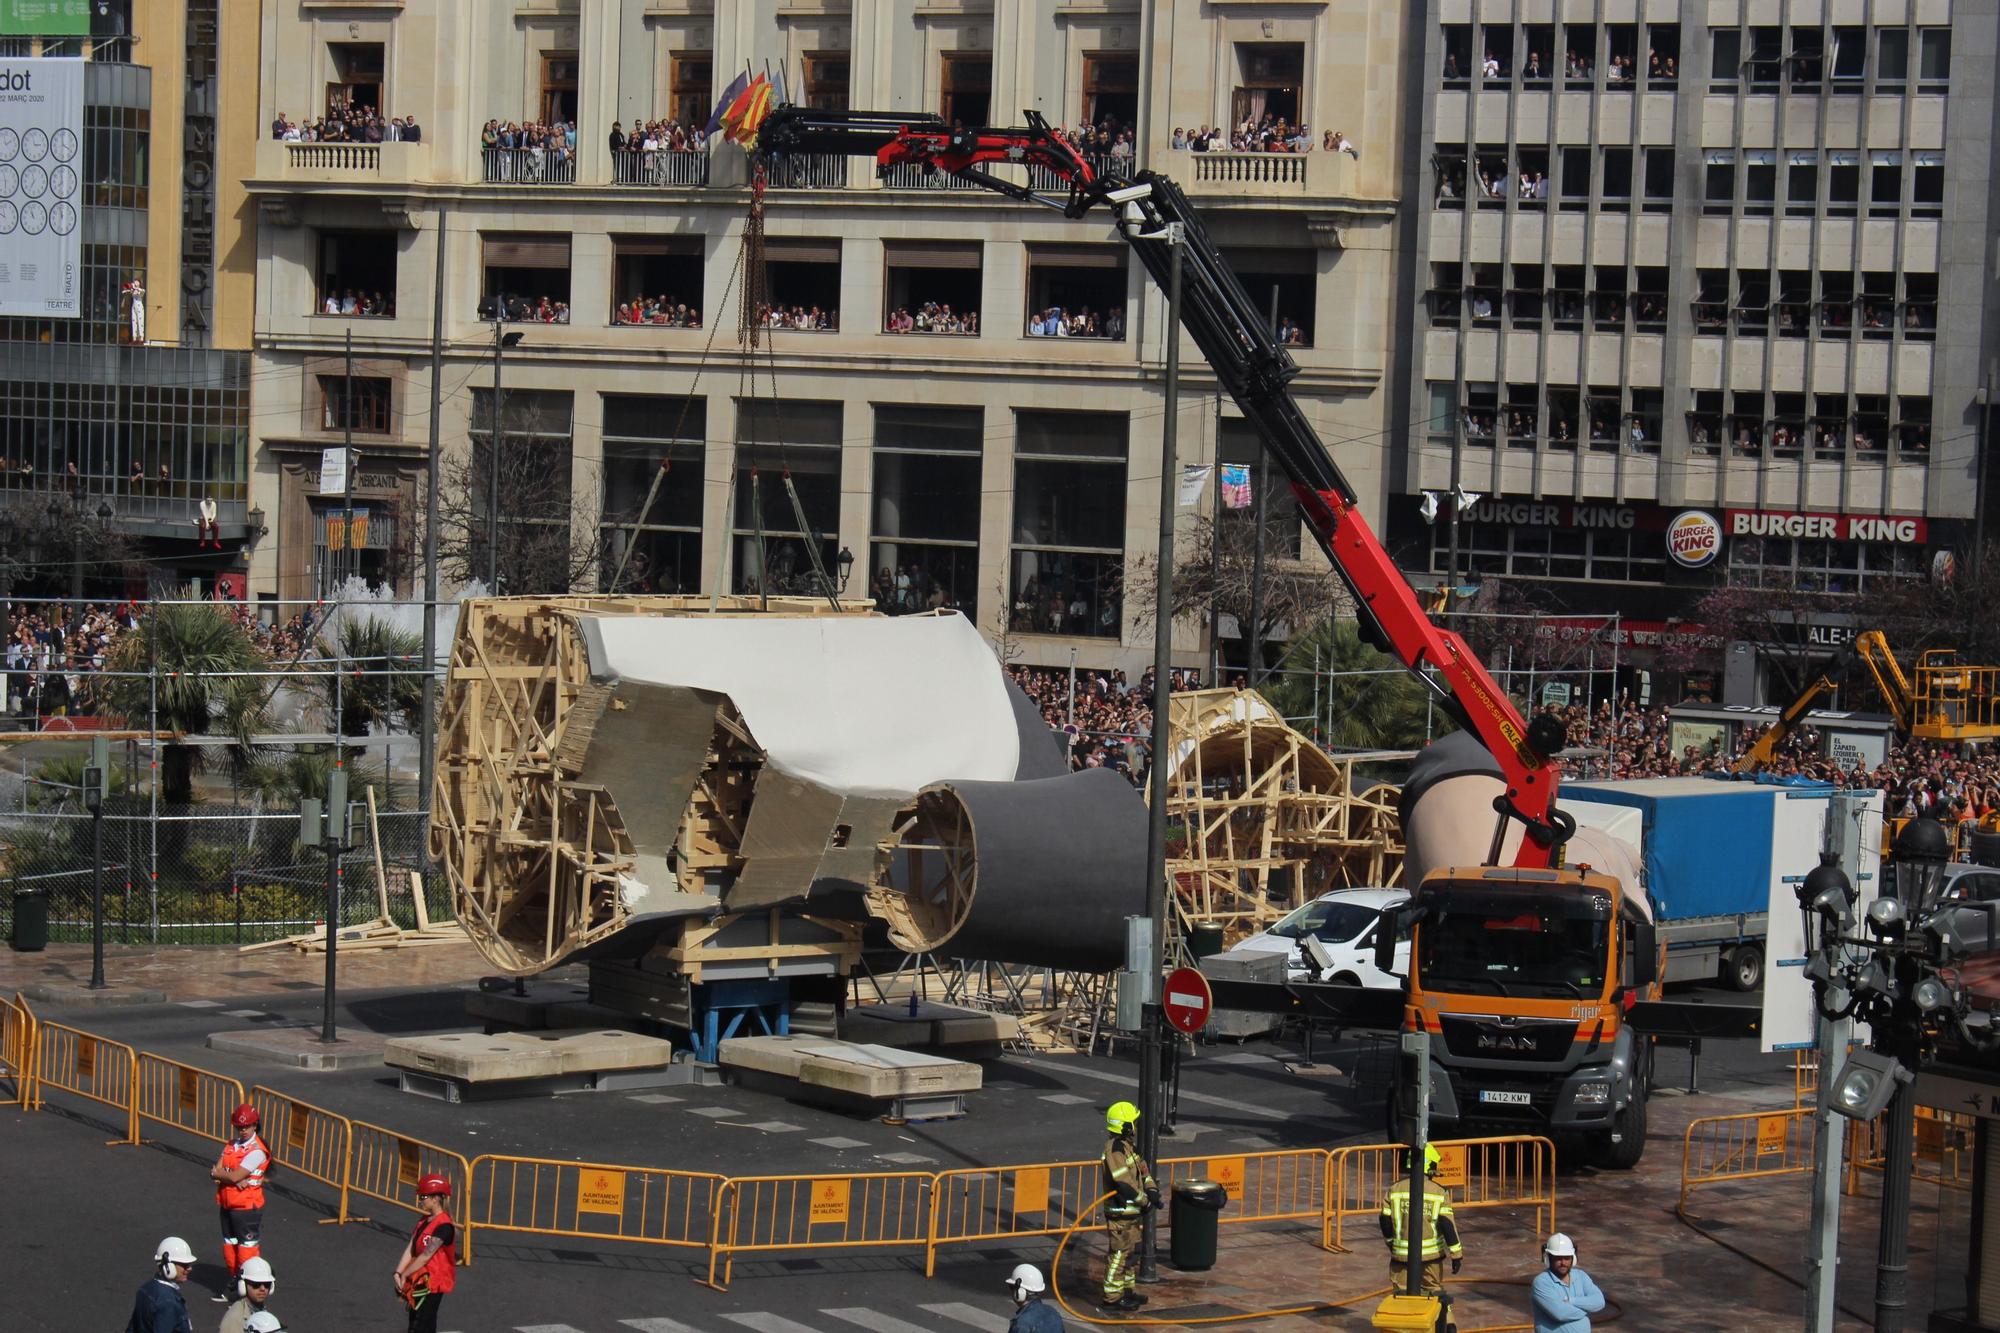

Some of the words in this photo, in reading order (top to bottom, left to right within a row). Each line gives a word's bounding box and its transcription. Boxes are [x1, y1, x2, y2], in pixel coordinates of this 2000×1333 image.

[65, 264, 73, 294] RIALTO
[47, 301, 73, 309] TEATRE
[1462, 502, 1560, 527] BURGER
[1572, 506, 1636, 529] KING
[1673, 526, 1715, 540] BURGER
[1733, 512, 1837, 539] BURGER
[1849, 517, 1917, 543] KING
[1673, 535, 1715, 554] KING
[1478, 1033, 1537, 1050] MAN
[1487, 1092, 1510, 1103] 1412
[1511, 1094, 1529, 1104] KMY
[583, 1192, 619, 1200] AJUNTAMENT
